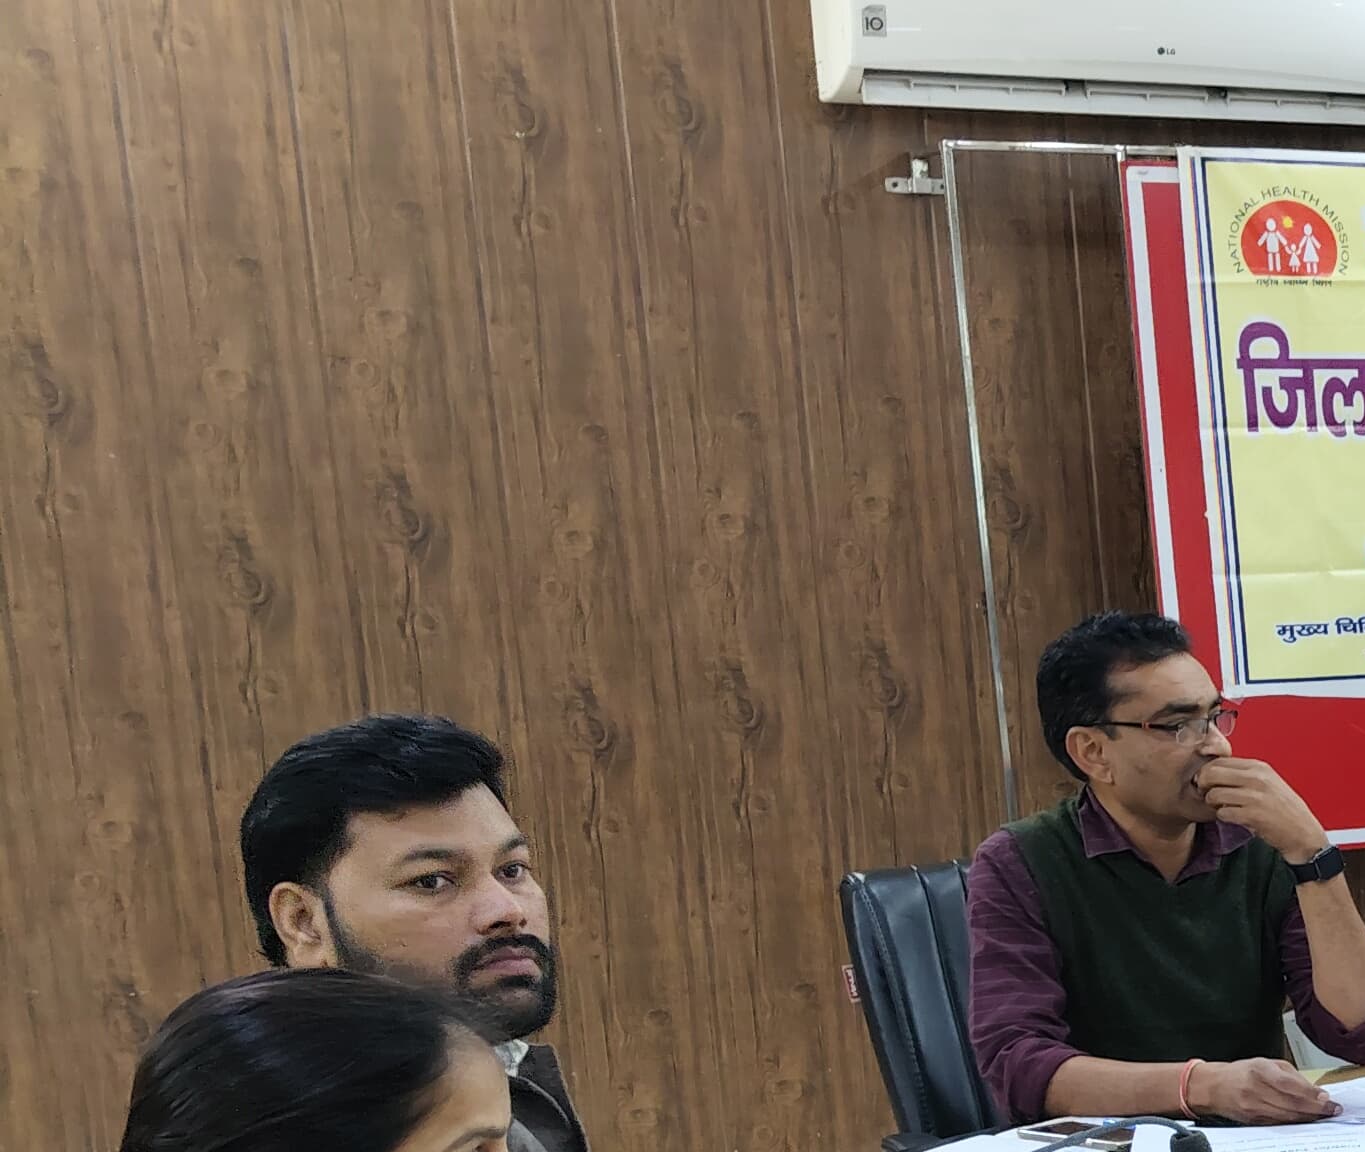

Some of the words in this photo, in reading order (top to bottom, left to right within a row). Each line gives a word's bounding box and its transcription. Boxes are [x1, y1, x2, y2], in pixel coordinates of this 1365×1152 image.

[1227, 197, 1259, 274] NATIONAL
[1260, 185, 1320, 207] HEALTH
[1322, 204, 1350, 276] MISSION
[1275, 622, 1329, 643] मुख्य
